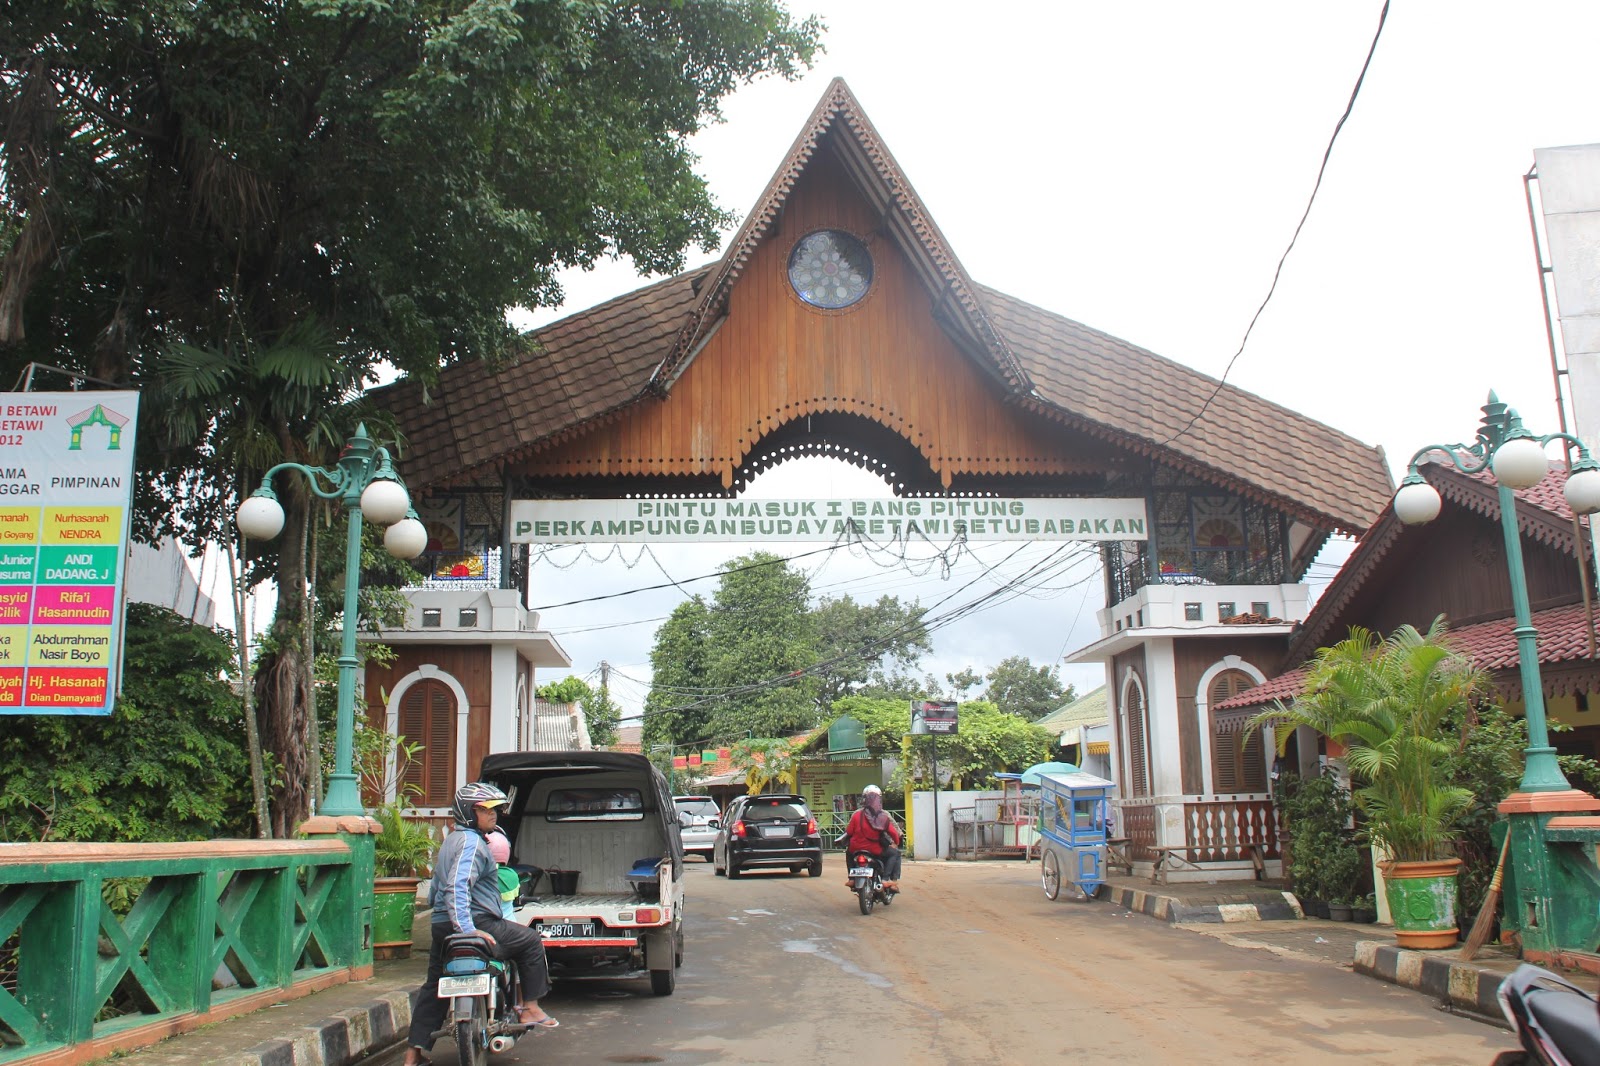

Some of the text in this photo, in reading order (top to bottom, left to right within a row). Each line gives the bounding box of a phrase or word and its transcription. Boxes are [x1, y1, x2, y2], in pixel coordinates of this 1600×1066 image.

[7, 405, 57, 416] BETAWI
[0, 420, 43, 431] ETAWI
[51, 477, 121, 488] PIMPINAN
[637, 501, 1025, 518] PINTU MASUK I BANG PITUNG
[55, 513, 109, 523] Nurhasanah
[4, 530, 34, 541] Goyang
[59, 530, 102, 539] NENDRA
[0, 554, 34, 565] Junior
[64, 554, 93, 565] ANDI
[45, 569, 109, 580] DADANG. J
[33, 634, 108, 645] Abdurrahman
[40, 649, 100, 662] Nasir Boyo
[29, 676, 105, 689] Hj. Hasanah
[30, 694, 102, 704] Dian Damayanti
[551, 924, 573, 936] 9870
